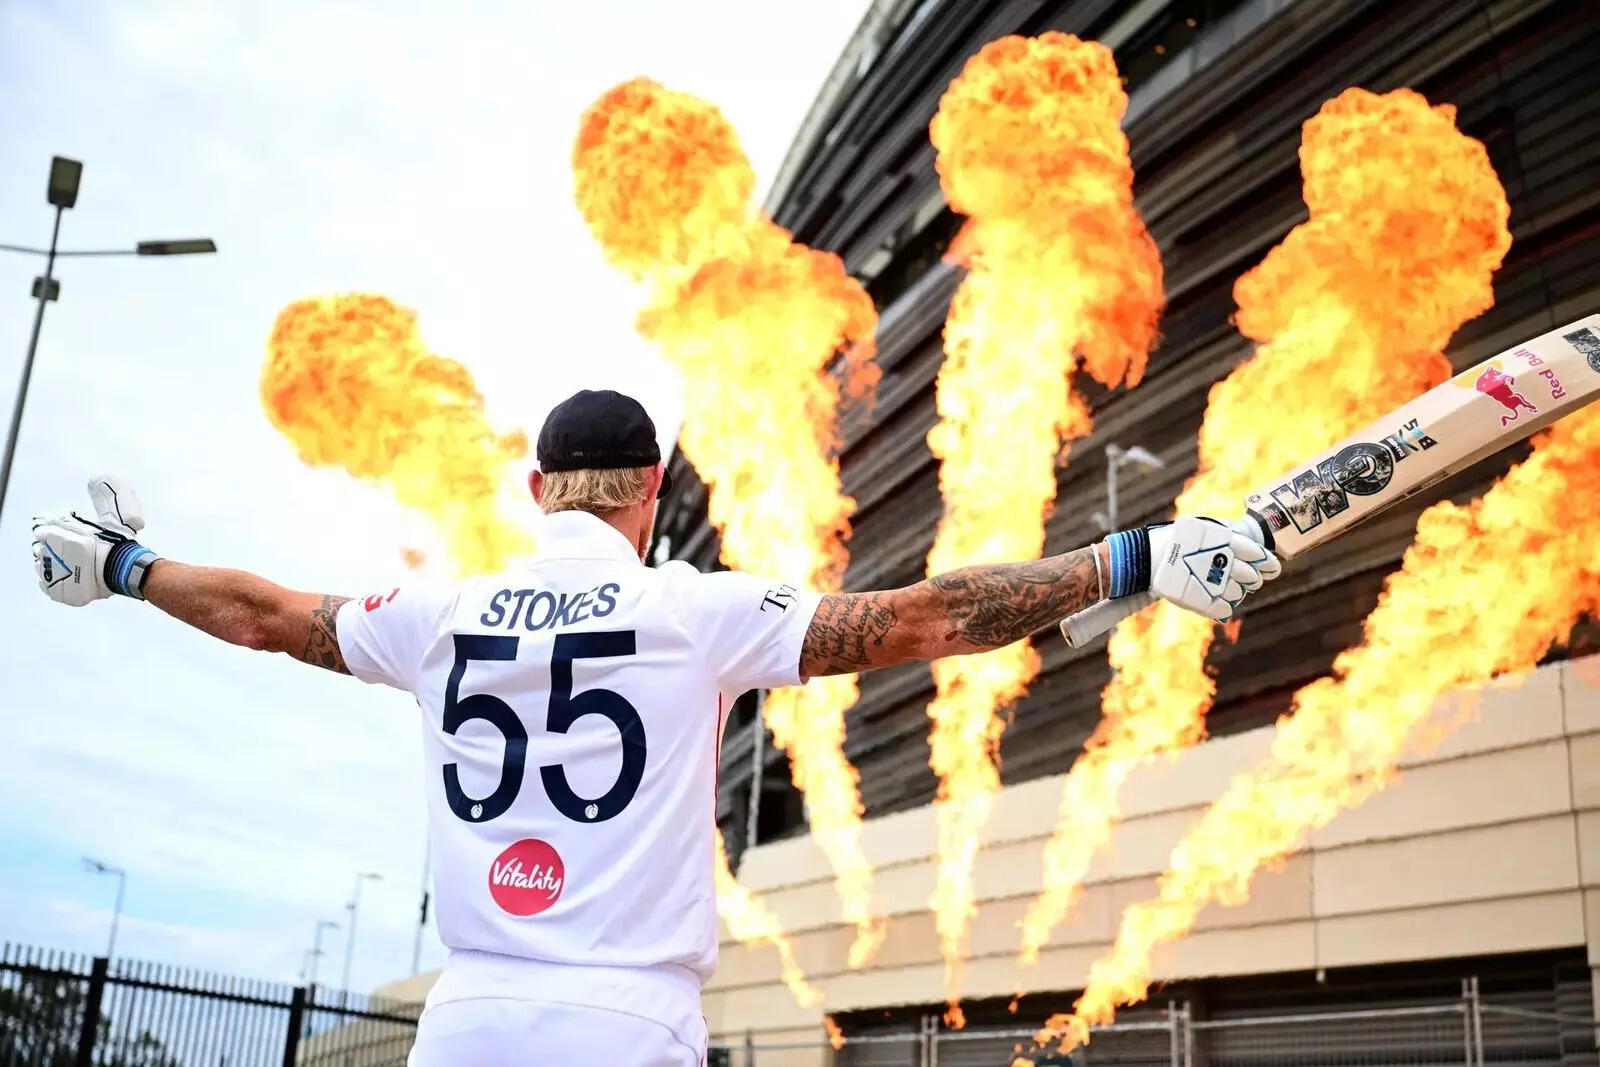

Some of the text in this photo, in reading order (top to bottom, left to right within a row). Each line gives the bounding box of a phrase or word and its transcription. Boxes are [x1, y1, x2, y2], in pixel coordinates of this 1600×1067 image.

[1513, 348, 1567, 400] Red Bull
[1270, 442, 1394, 534] GM
[480, 582, 621, 631] STOKES
[442, 630, 648, 823] 55
[492, 857, 562, 900] Vitality
